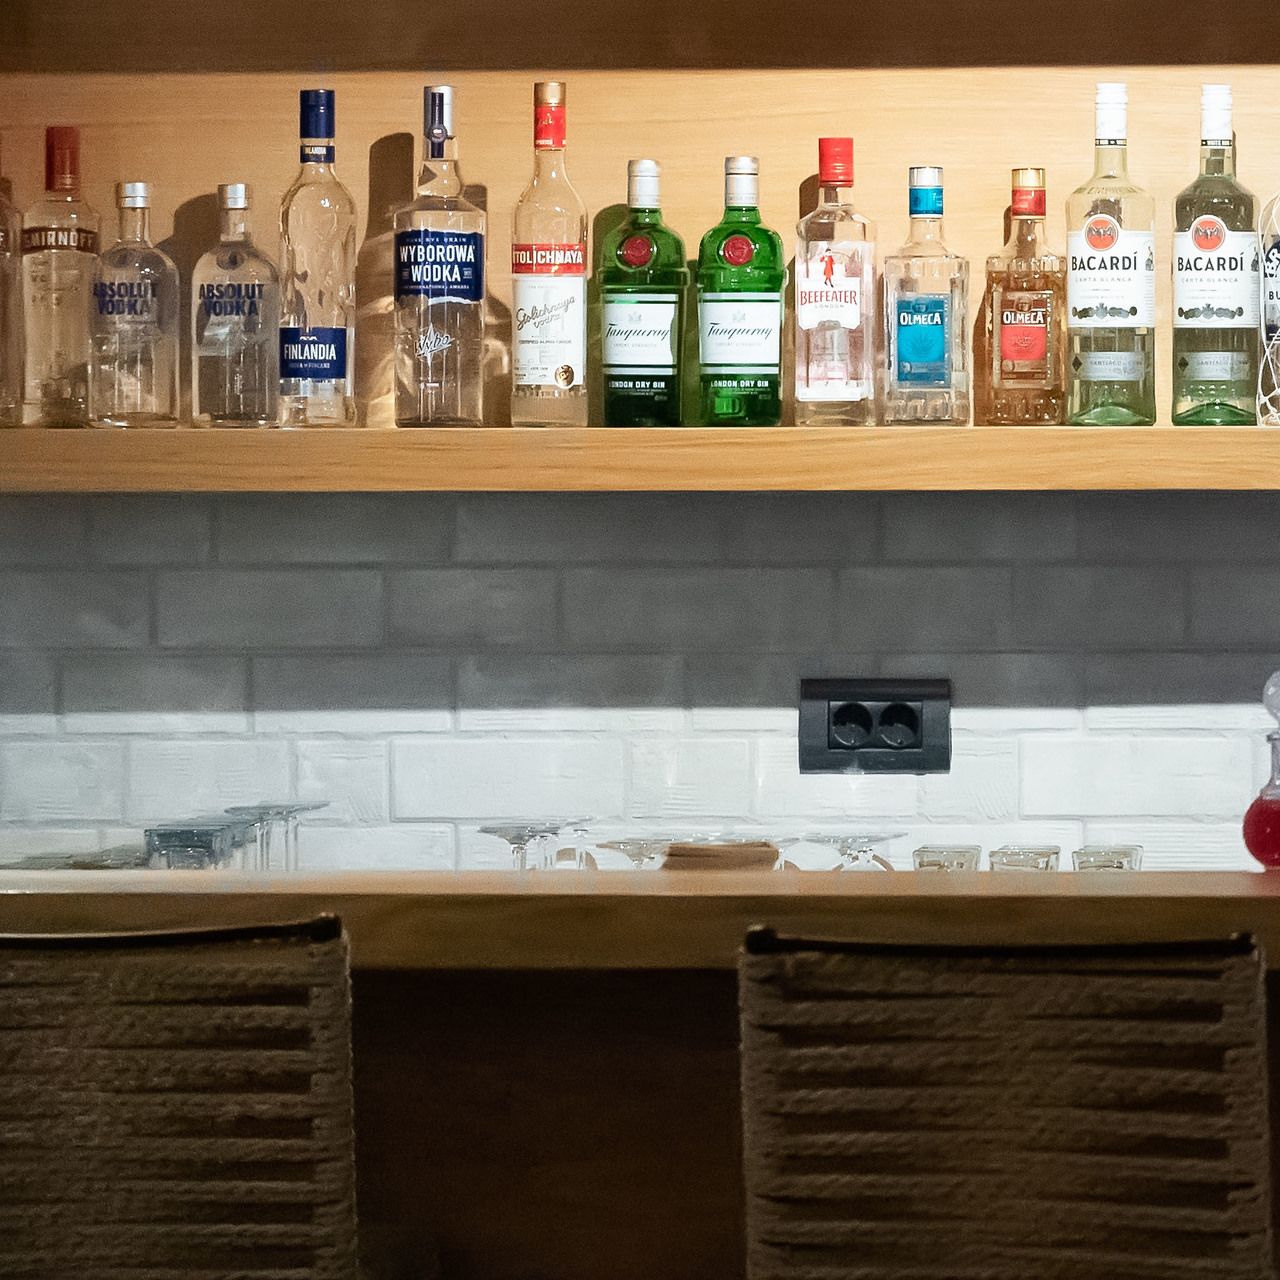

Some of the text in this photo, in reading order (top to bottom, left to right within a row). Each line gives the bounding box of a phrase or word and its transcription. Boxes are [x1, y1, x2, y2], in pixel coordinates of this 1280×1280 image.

[400, 244, 475, 262] WYBOROWA
[1072, 251, 1138, 271] BACARDÍ
[1178, 252, 1244, 272] BACARDÍ
[411, 261, 461, 282] WÓDKA
[94, 282, 159, 298] ABSOLUT
[199, 283, 265, 300] ABSOLUT
[800, 289, 858, 306] BEEFEATER
[99, 299, 150, 316] VODKA
[204, 300, 259, 317] VODKA
[900, 312, 942, 325] OLMECA
[1003, 311, 1044, 324] OLMECA
[606, 323, 670, 341] Tanqueray
[708, 322, 773, 340] Tanqueray
[284, 343, 337, 360] FINLANDIA
